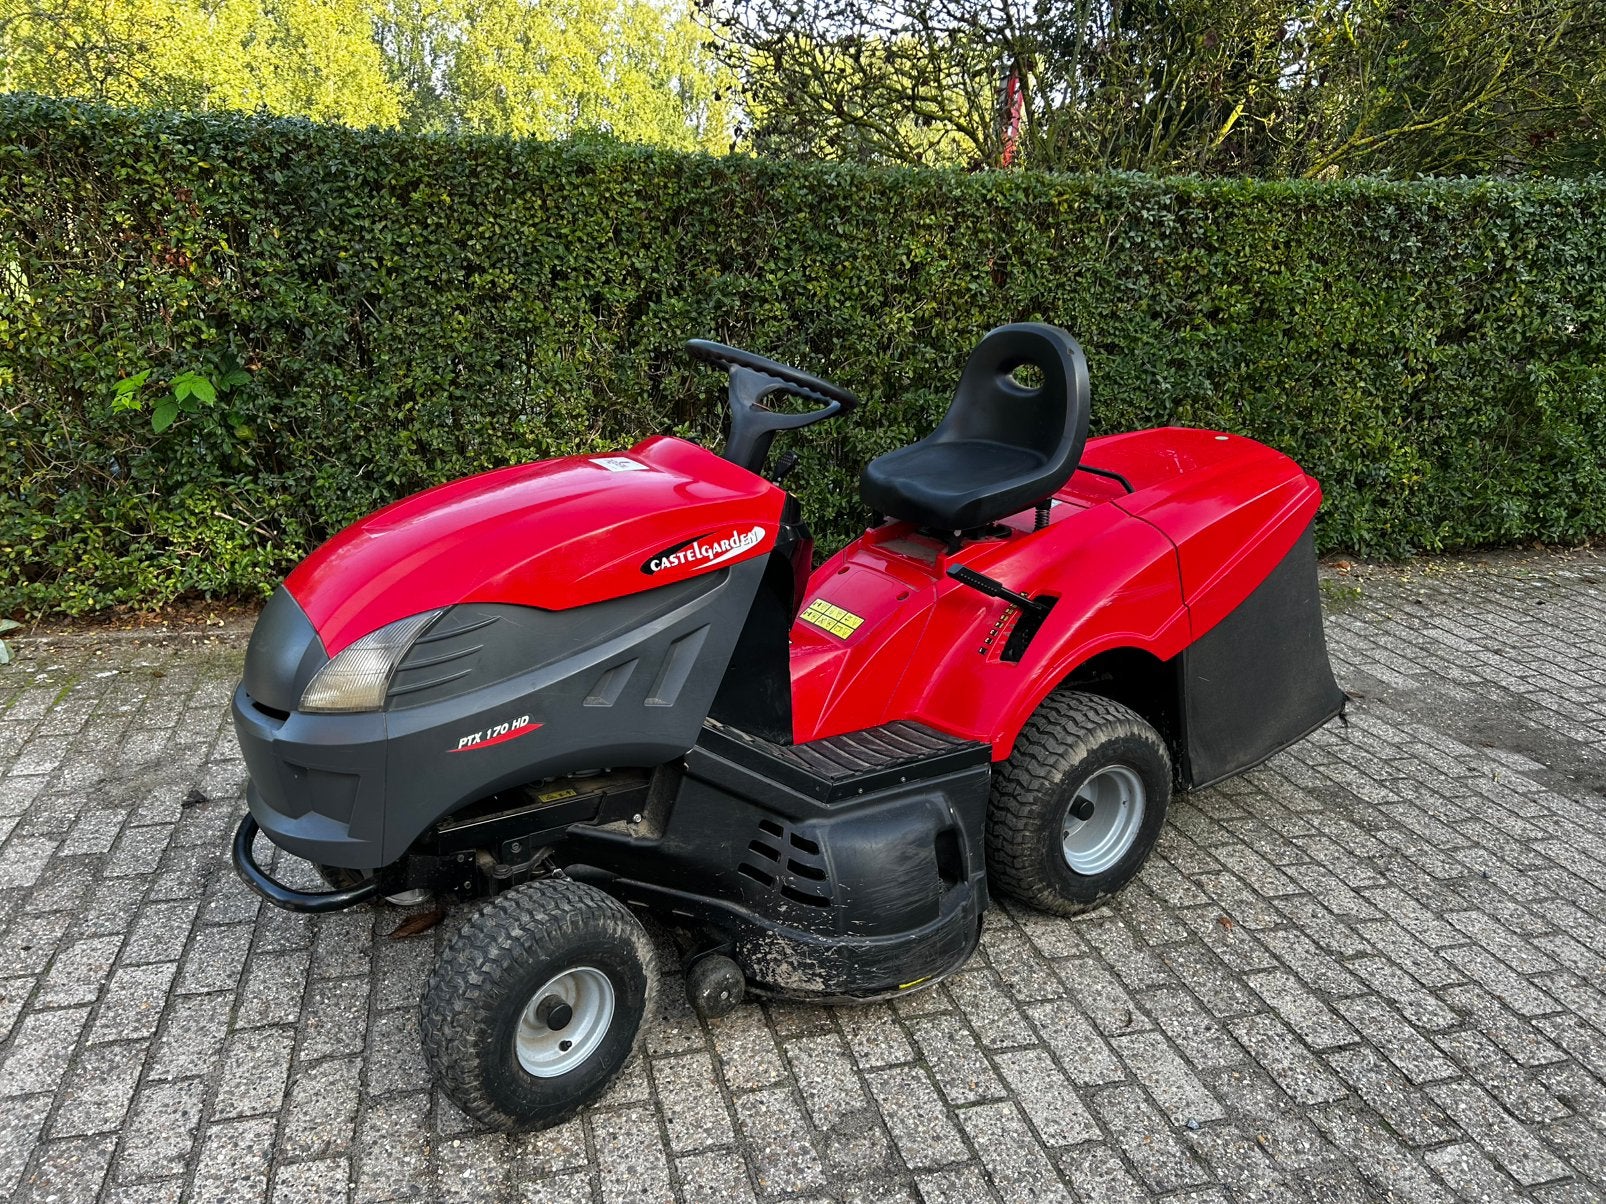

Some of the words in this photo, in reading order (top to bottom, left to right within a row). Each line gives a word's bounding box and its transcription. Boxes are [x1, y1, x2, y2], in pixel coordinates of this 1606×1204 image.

[458, 731, 482, 749] PTX
[486, 723, 509, 740] 170
[511, 715, 530, 730] HD
